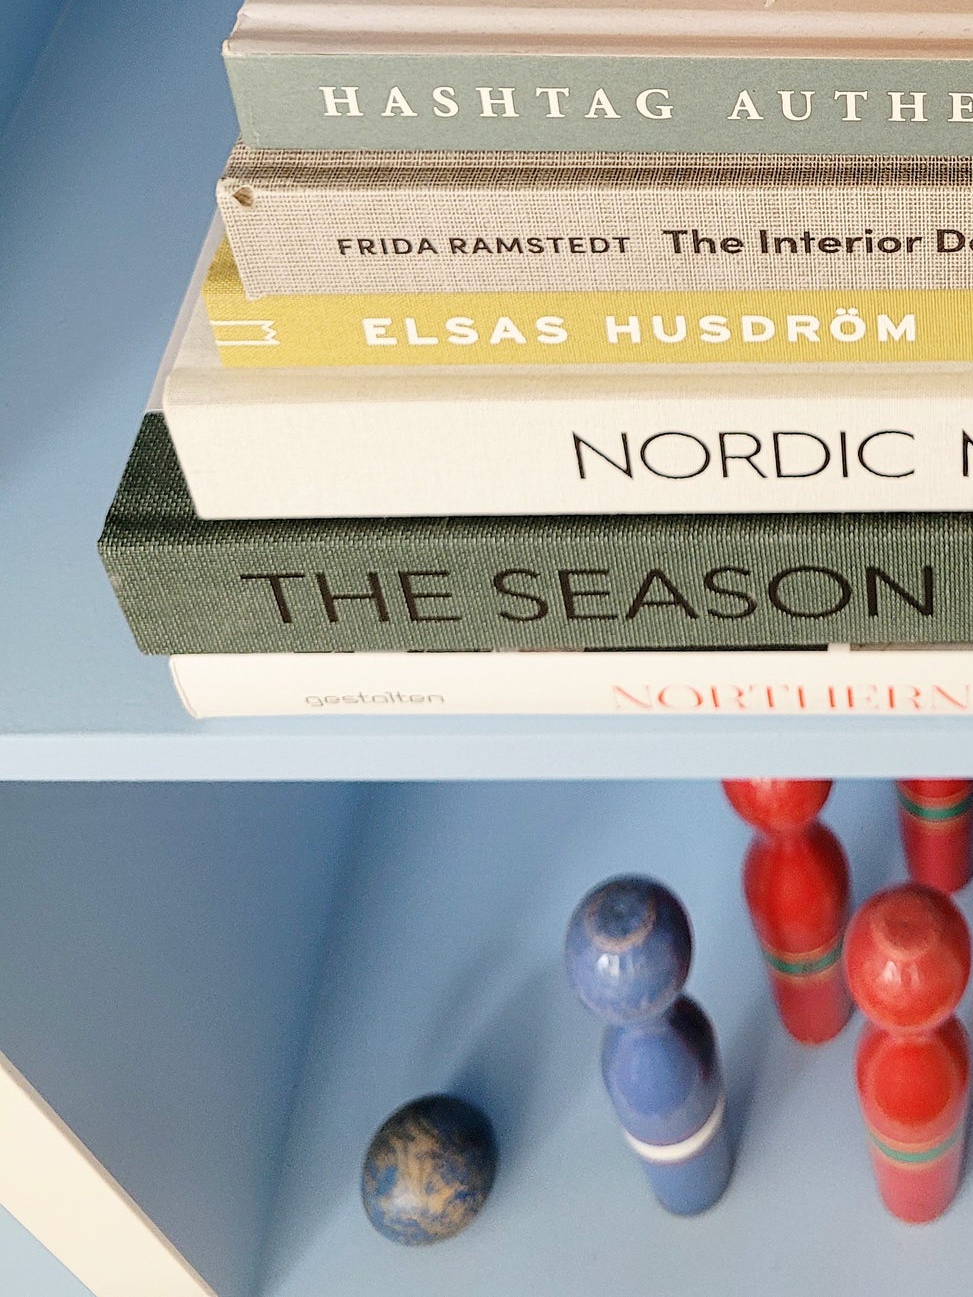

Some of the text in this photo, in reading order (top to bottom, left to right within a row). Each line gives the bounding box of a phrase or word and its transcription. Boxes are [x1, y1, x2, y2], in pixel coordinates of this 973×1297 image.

[319, 85, 675, 121] HASHTAG
[337, 236, 631, 256] FRIDA RAMSTEDT
[663, 229, 745, 255] The
[759, 229, 922, 255] Interior
[362, 307, 916, 347] ELSAS HUSDRÖM
[572, 430, 914, 480] NORDIC
[240, 564, 934, 624] THE SEASON
[304, 690, 446, 708] gestalten
[612, 684, 970, 711] NORTHERN
